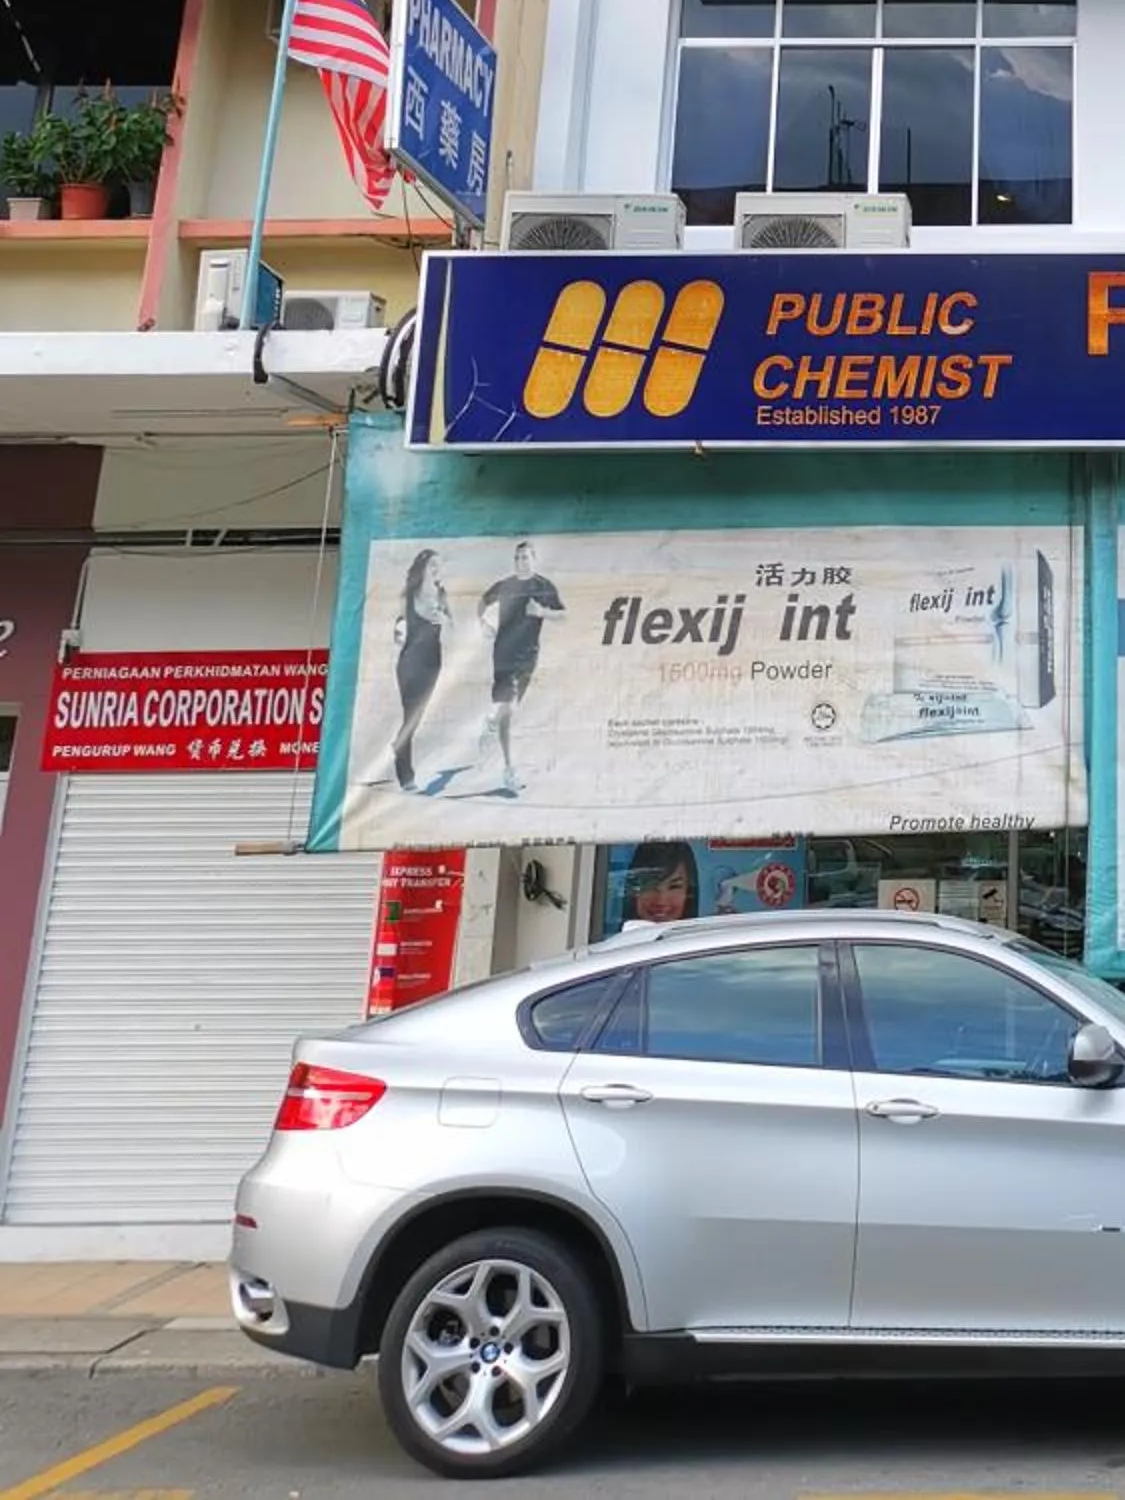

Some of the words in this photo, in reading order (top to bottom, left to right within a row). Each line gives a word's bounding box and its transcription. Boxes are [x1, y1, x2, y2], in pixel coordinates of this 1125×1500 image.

[765, 291, 978, 336] PUBLIC
[752, 353, 1013, 400] CHEMIST
[756, 405, 882, 426] Established
[889, 405, 942, 426] 1987
[62, 666, 161, 680] PERNIAGAAN
[163, 665, 281, 679] PERKHIDMATAN
[284, 662, 329, 677] WANG
[750, 658, 833, 682] Powder
[54, 690, 139, 729] SUNRIA
[143, 687, 305, 728] CORPORATION
[52, 744, 132, 758] PENGURUP
[133, 743, 178, 757] WANG
[889, 815, 966, 831] Promote
[969, 812, 1036, 830] healthy
